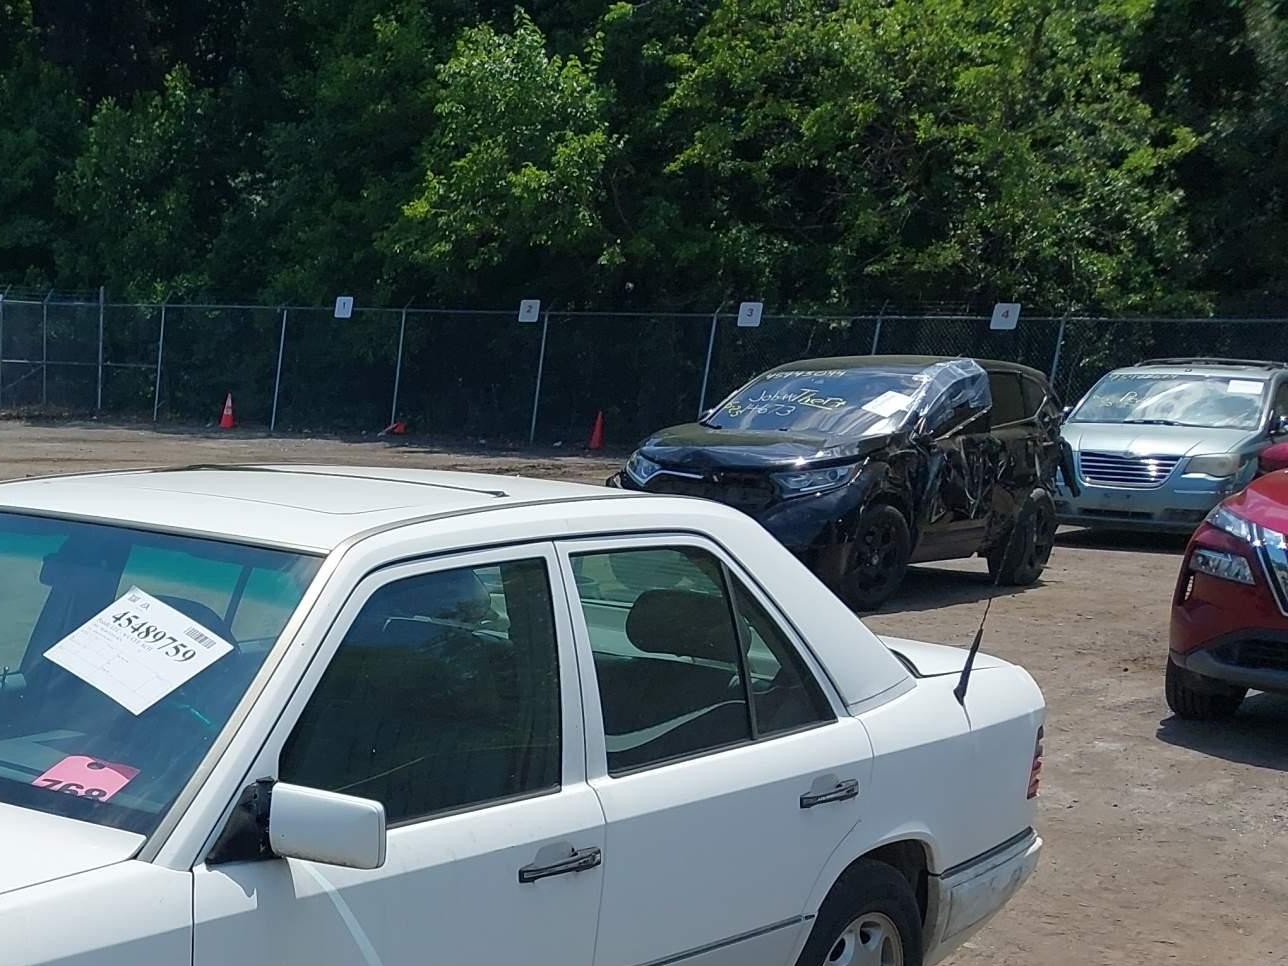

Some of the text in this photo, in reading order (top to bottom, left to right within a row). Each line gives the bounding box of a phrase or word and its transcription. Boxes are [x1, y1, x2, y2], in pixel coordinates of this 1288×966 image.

[526, 304, 533, 313] 2
[746, 308, 754, 317] 3
[1001, 309, 1009, 319] 4
[112, 611, 197, 663] 45489759
